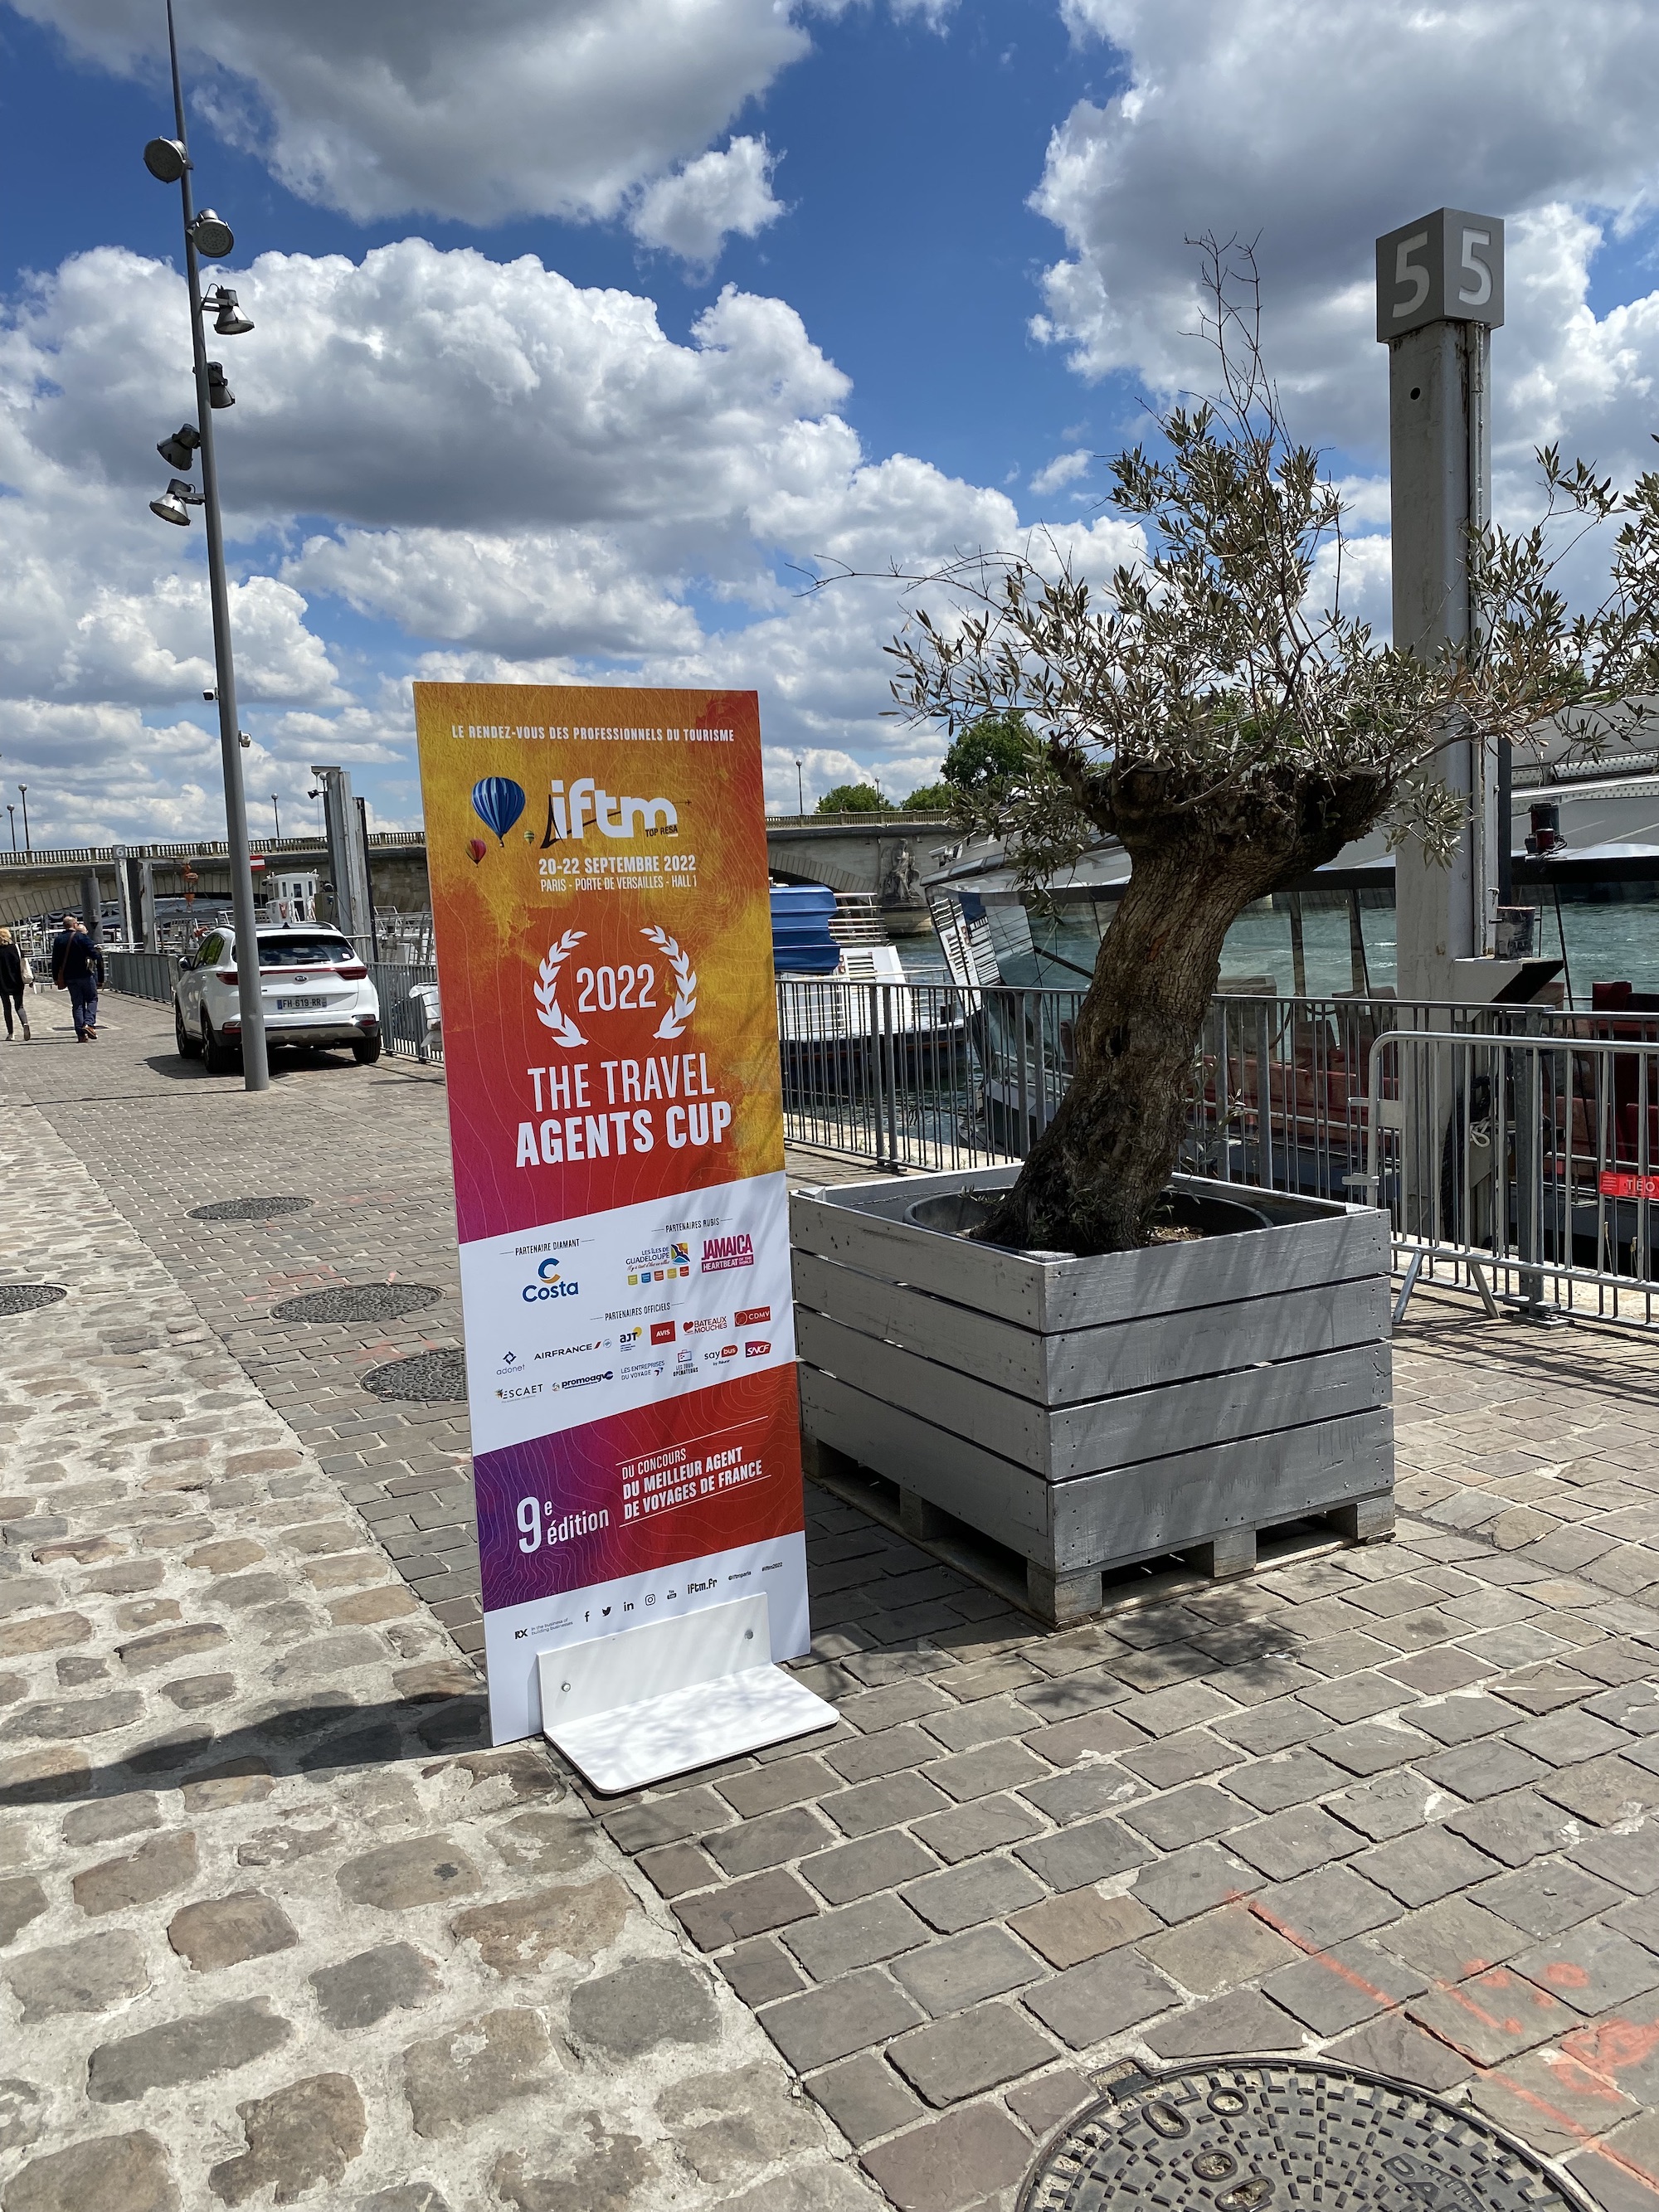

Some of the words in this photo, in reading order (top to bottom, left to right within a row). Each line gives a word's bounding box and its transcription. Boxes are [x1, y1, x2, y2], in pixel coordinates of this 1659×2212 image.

[1392, 231, 1430, 318] 5
[1458, 226, 1493, 306] 5
[451, 725, 465, 739] LE
[469, 725, 545, 740] RENDEZ-VOUS
[549, 727, 569, 740] DES
[573, 727, 663, 741] PROFESSIONNELS
[666, 728, 680, 741] DU
[684, 729, 735, 742] TOURISME
[551, 777, 679, 839] iftm
[645, 828, 659, 838] TOP
[660, 824, 679, 835] RESA
[115, 846, 124, 857] 6
[539, 857, 581, 876] 20-22
[584, 855, 660, 874] SEPTEMBRE
[664, 854, 697, 872] 2022
[541, 878, 567, 892] PARIS
[576, 877, 602, 892] PORTE
[604, 877, 615, 891] DE
[617, 875, 664, 890] VERSAILLES
[672, 874, 692, 888] HALL
[693, 874, 698, 887] 1
[577, 963, 657, 1014] 2022
[528, 1062, 591, 1112] THE
[601, 1052, 715, 1106] TRAVEL
[516, 1108, 654, 1168] AGENTS
[665, 1100, 732, 1150] CUP
[665, 1220, 703, 1233] PARTENAIRES
[515, 1242, 552, 1257] PARTENAIRE
[552, 1238, 581, 1251] DIAMANT
[701, 1233, 753, 1261] JAMAICA
[625, 1252, 670, 1266] GUADELOUPE
[703, 1258, 739, 1271] HEARTBEAT
[522, 1281, 580, 1303] Costa
[605, 1306, 643, 1321] PARTENAIRES
[644, 1301, 672, 1315] OFFICIELS
[693, 1315, 727, 1328] BATEAUX
[693, 1322, 727, 1334] MOUCHES
[655, 1329, 671, 1338] AVIS
[703, 1350, 721, 1360] say
[722, 1347, 737, 1355] bus
[746, 1344, 771, 1356] SNCF
[496, 1363, 526, 1376] adonet
[630, 1369, 652, 1379] VOYAGE
[631, 1359, 665, 1373] ENTREPRISES
[621, 1465, 635, 1480] DU
[637, 1447, 687, 1475] CONCOURS
[623, 1480, 640, 1500] DU
[643, 1460, 703, 1494] MEILLEUR
[705, 1446, 743, 1473] AGENT
[624, 1500, 640, 1520] DE
[642, 1481, 698, 1514] VOYAGES
[699, 1474, 715, 1495] DE
[718, 1459, 763, 1489] FRANCE
[547, 1507, 610, 1547] édition
[687, 1578, 718, 1595] iftm.fr
[514, 1628, 529, 1640] RX
